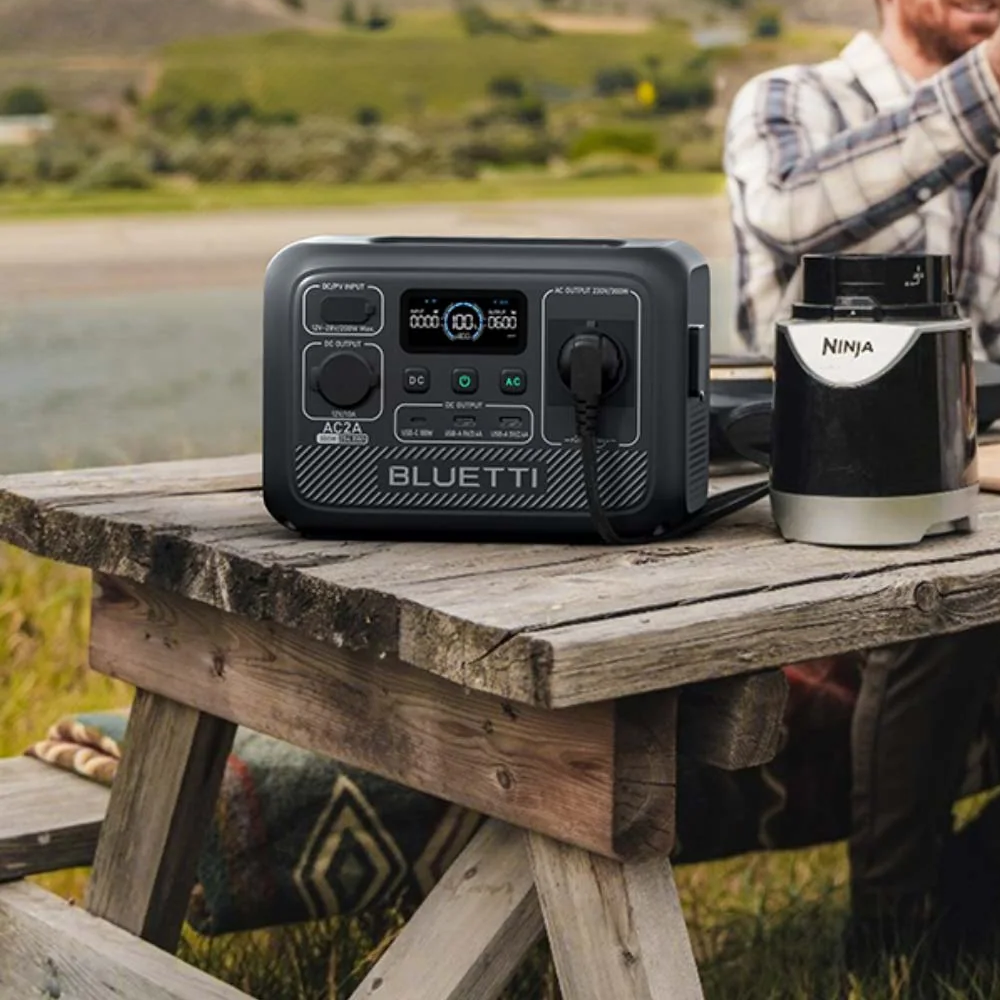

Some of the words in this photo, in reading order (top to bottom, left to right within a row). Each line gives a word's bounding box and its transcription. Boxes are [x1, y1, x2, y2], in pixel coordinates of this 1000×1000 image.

[822, 337, 874, 358] NINJA
[408, 376, 425, 386] DC
[505, 377, 521, 386] AC
[323, 421, 362, 433] AC2A
[389, 465, 538, 488] BLUETTI
